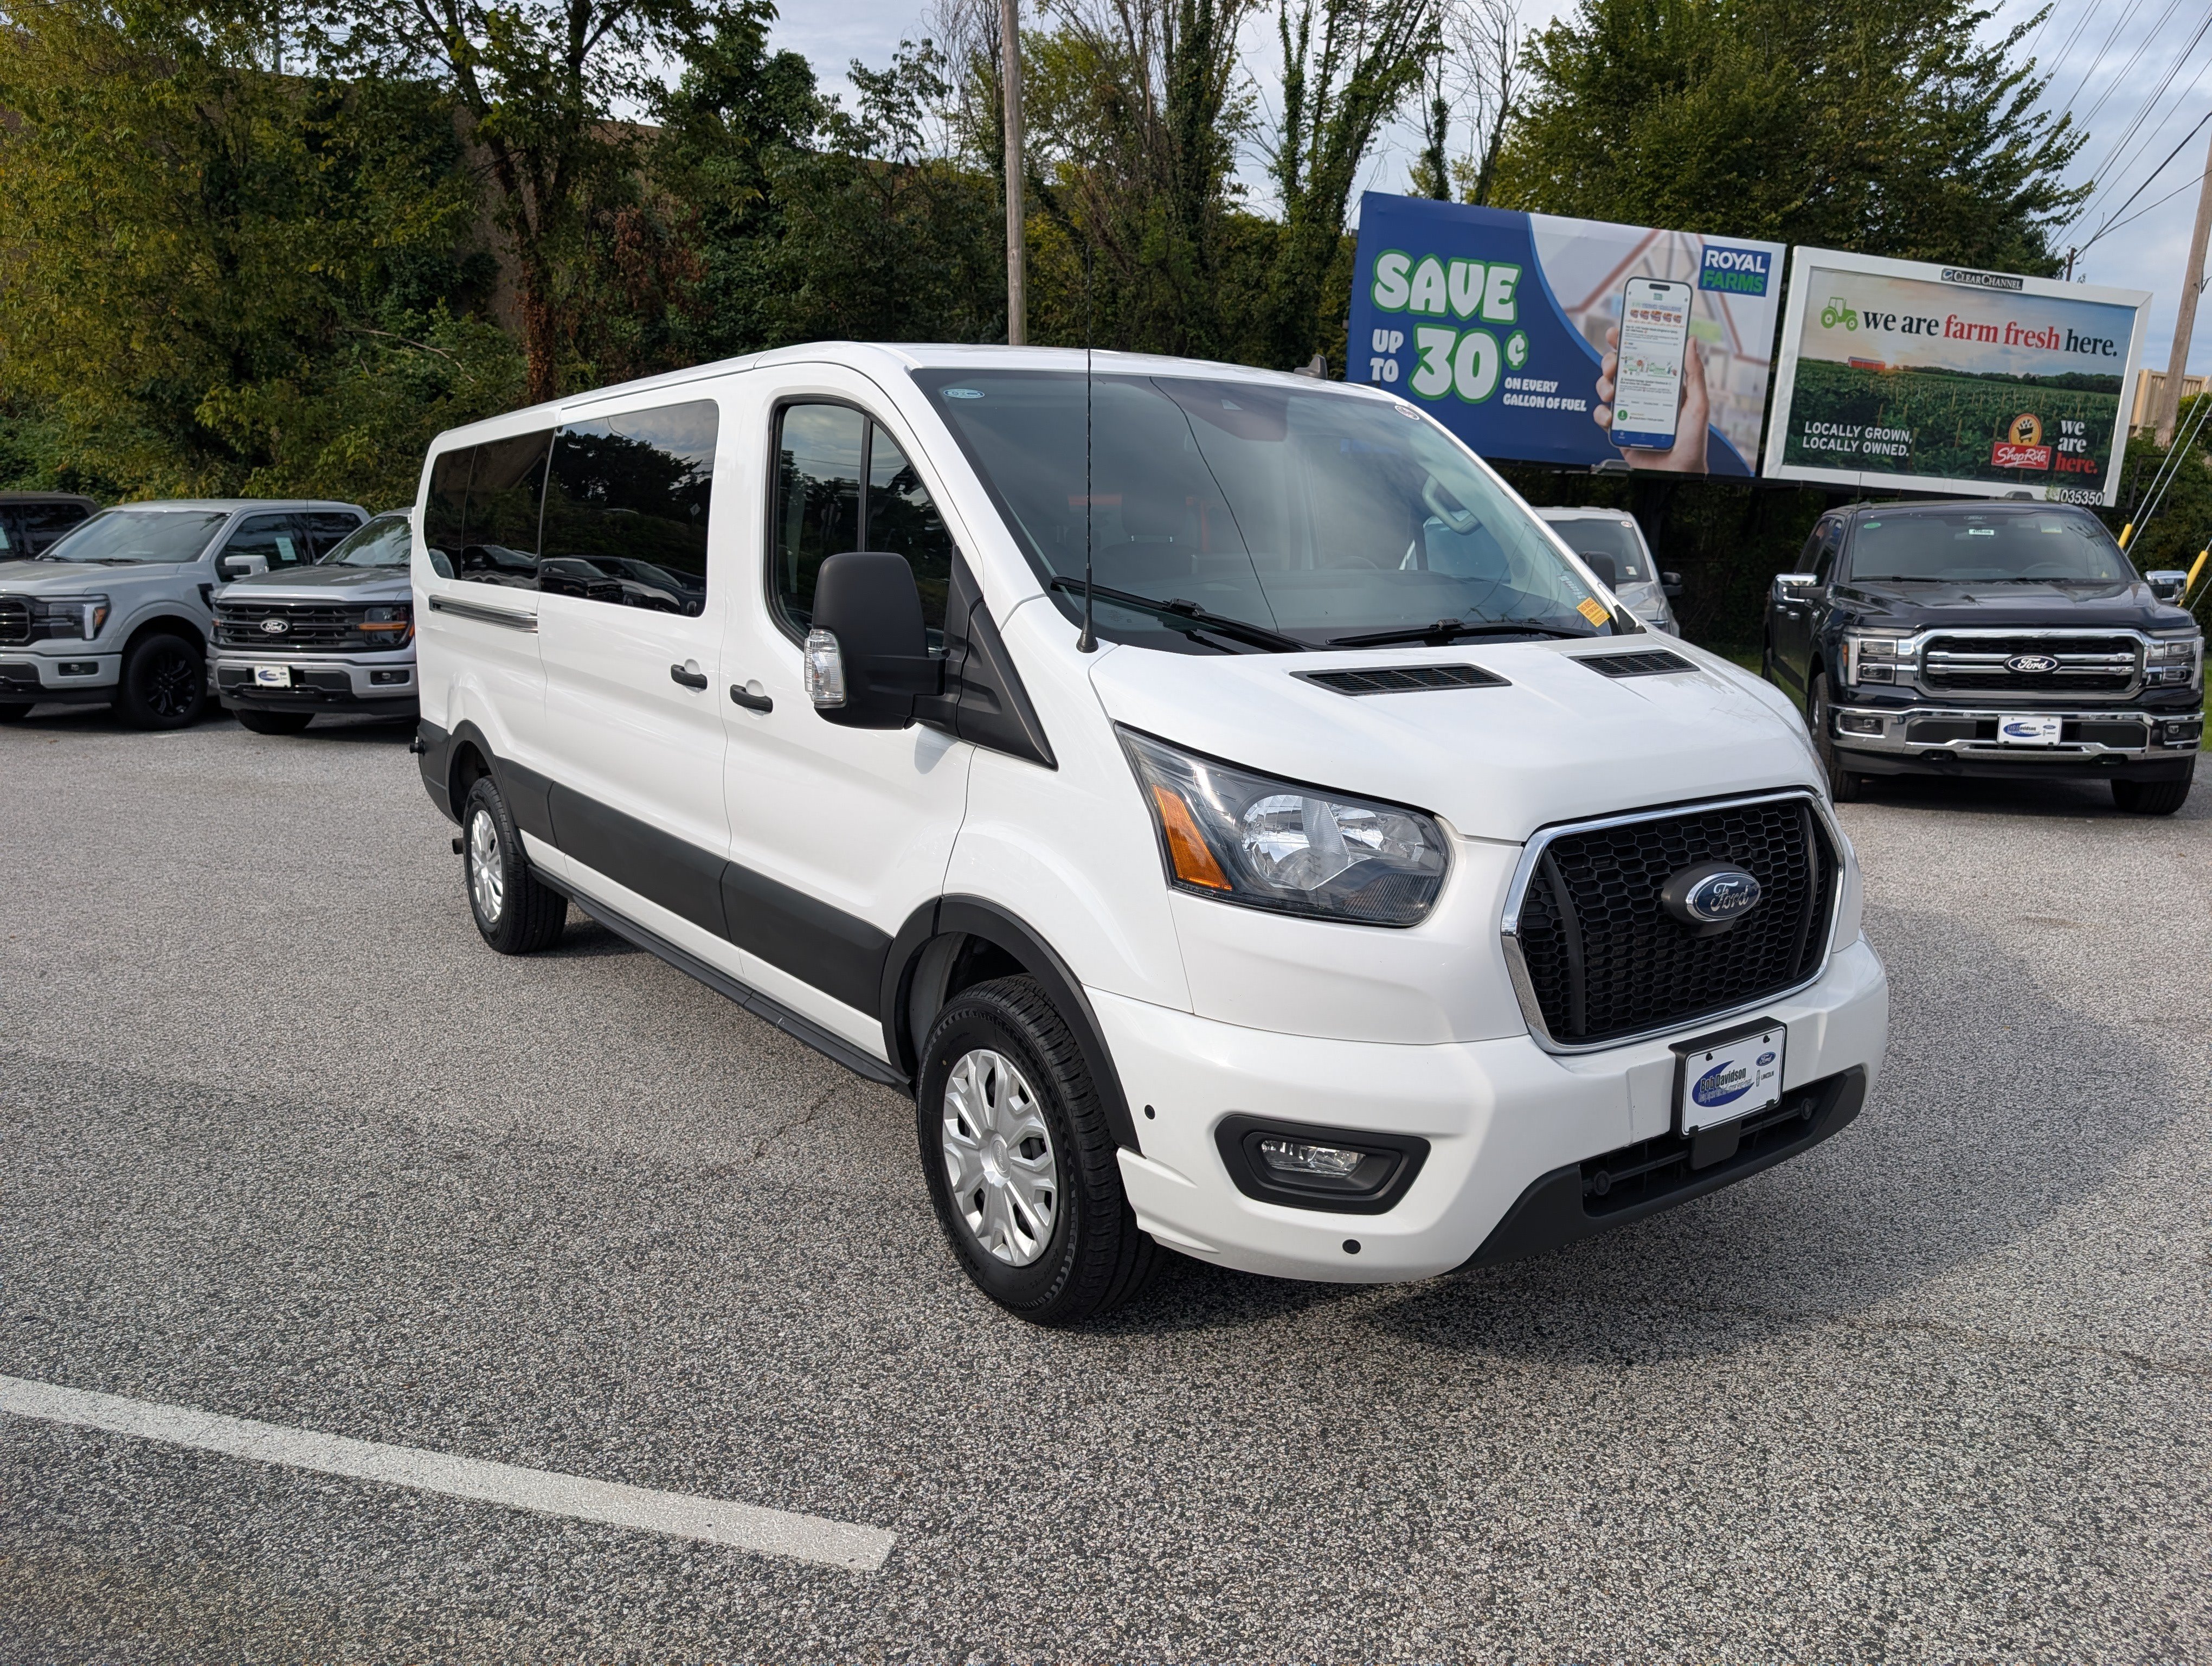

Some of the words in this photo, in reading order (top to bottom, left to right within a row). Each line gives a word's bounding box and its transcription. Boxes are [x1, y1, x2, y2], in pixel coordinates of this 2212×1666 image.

[1705, 249, 1766, 274] ROYAL
[1374, 253, 1519, 321] SAVE
[1702, 270, 1764, 292] FARMS
[1372, 329, 1404, 354] UP
[1862, 311, 1896, 331] we
[1901, 316, 1939, 336] are
[1943, 314, 1998, 343] farm
[2003, 321, 2060, 350] fresh
[2063, 328, 2117, 357] here.
[1370, 357, 1399, 382] TO
[1504, 376, 1521, 390] ON
[1522, 378, 1559, 393] EVERY
[1503, 393, 1545, 408] GALLON
[1546, 396, 1561, 409] OF
[1561, 398, 1587, 412] FUEL
[1804, 421, 1862, 438] LOCALLY
[1864, 427, 1913, 445] GROWN,
[2061, 420, 2085, 436] we
[1802, 435, 1860, 452] LOCALLY
[1862, 441, 1910, 457] OWNED.
[2057, 437, 2087, 453] are
[2054, 452, 2098, 475] here.
[2060, 489, 2104, 506] 035350
[2017, 657, 2049, 669] Ford
[1711, 881, 1750, 912] Ford
[1701, 1076, 1716, 1092] Bob
[1716, 1067, 1746, 1087] Davidson
